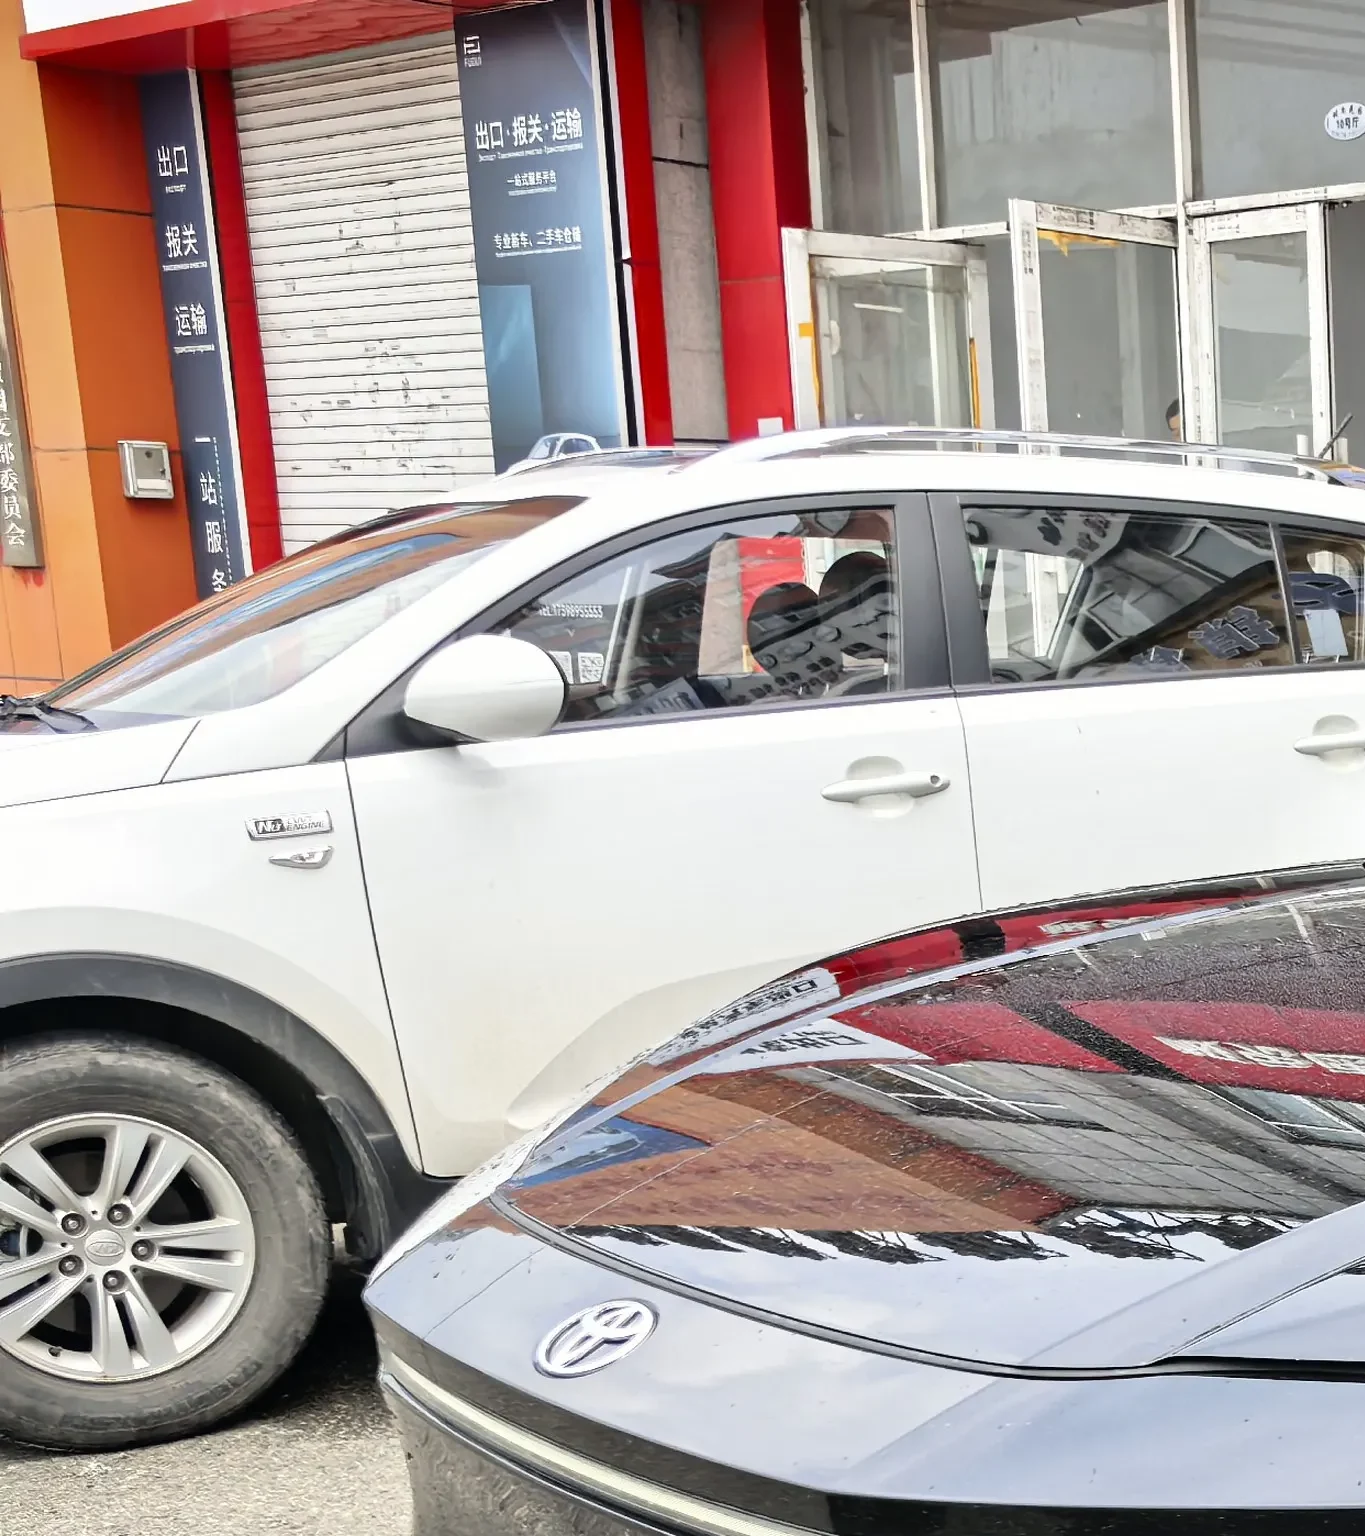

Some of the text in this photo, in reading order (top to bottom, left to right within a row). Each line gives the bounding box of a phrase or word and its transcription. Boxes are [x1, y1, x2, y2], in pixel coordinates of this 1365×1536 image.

[157, 145, 188, 176] 出口
[166, 224, 198, 257] 报关
[175, 303, 207, 336] 运输
